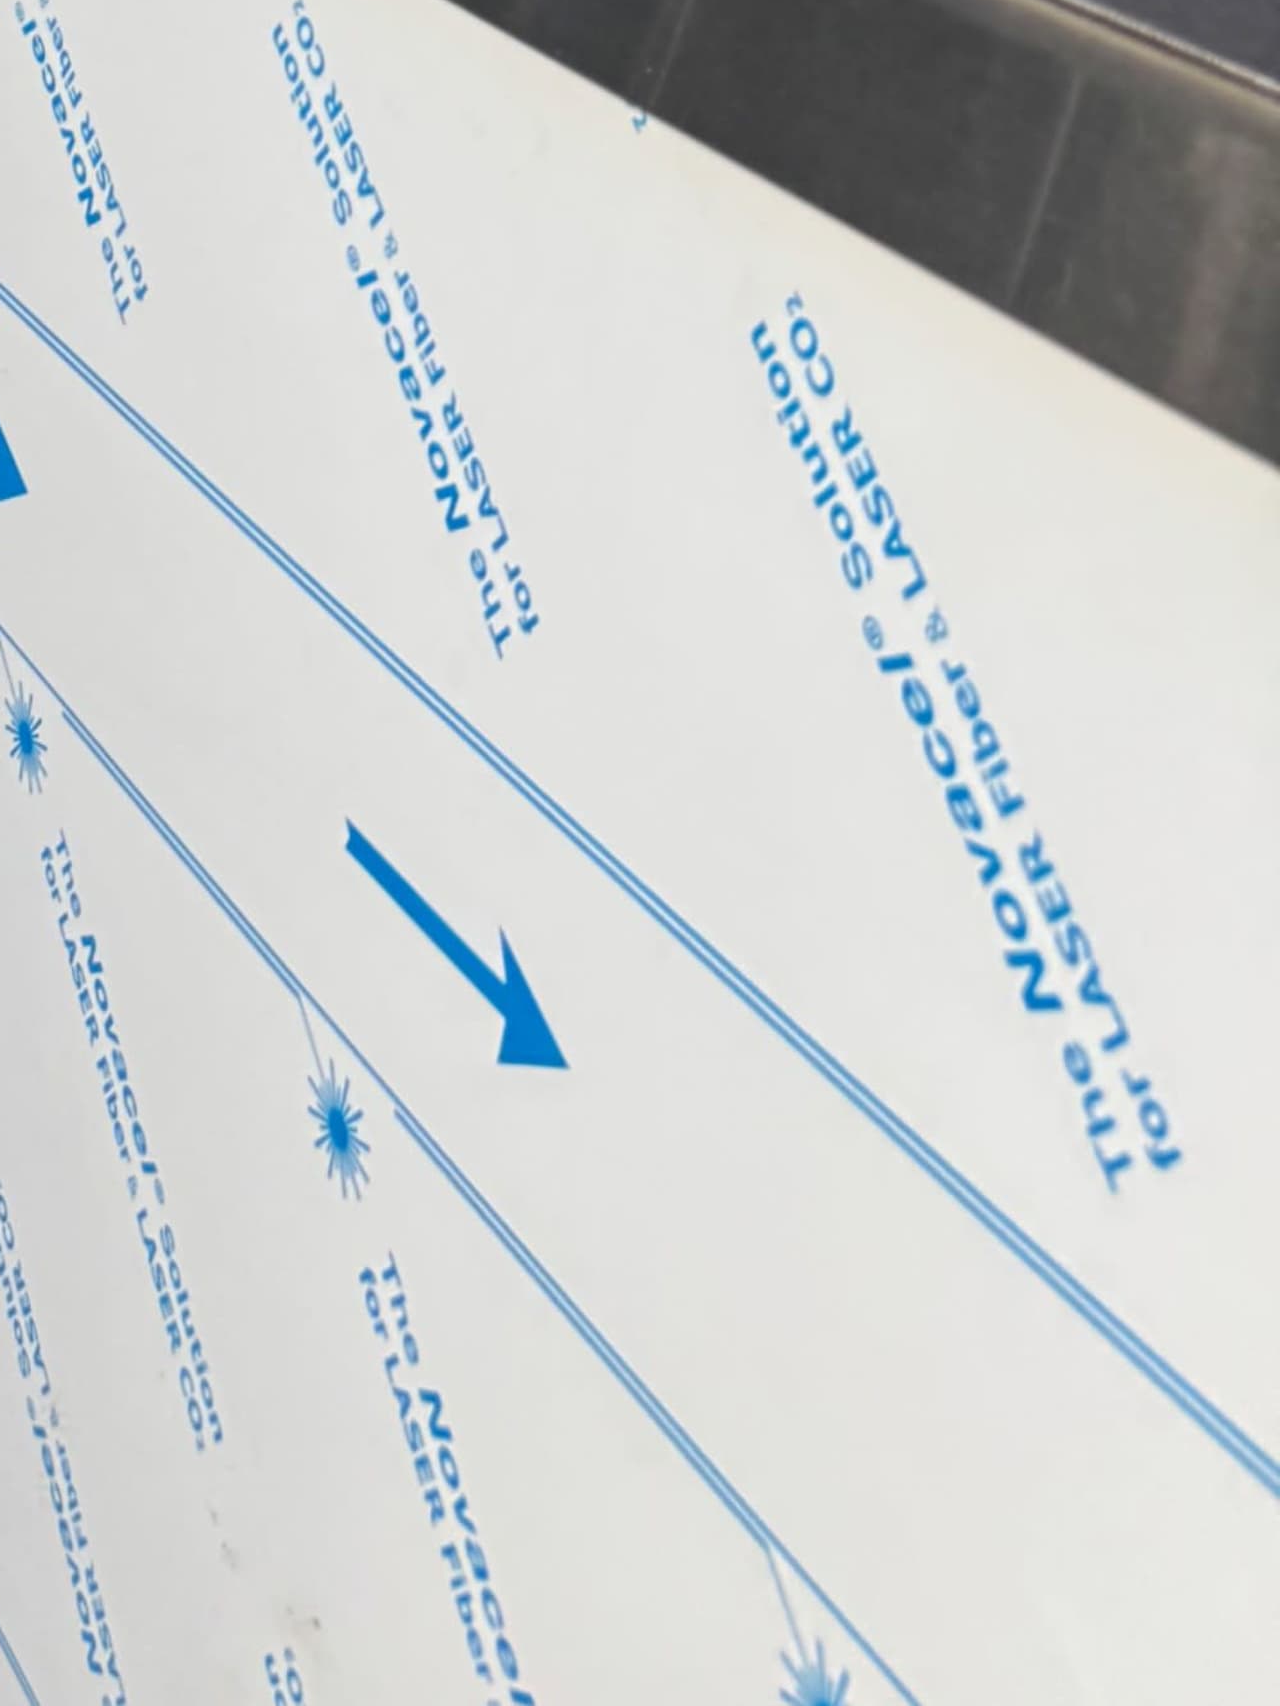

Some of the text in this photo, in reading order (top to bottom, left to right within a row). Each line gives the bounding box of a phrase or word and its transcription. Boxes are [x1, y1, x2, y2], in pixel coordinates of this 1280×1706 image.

[44, 16, 84, 111] Fiber
[270, 22, 353, 228] Solution
[78, 112, 128, 240] LASER
[322, 82, 387, 231] LASER
[99, 236, 131, 325] The
[122, 244, 149, 303] for
[383, 231, 399, 260] &
[393, 270, 448, 388] Fiber
[440, 391, 511, 555] LASER
[748, 320, 876, 594] Solution
[829, 404, 929, 603] LASER
[467, 548, 513, 661] The
[503, 562, 541, 637] for
[923, 607, 950, 645] &
[939, 659, 1028, 821] Fiber
[1018, 830, 1132, 1054] LASER
[39, 845, 62, 903] for
[56, 912, 101, 1047] LASER
[95, 1055, 131, 1163] Fiber
[134, 1207, 183, 1355] LASER
[54, 830, 82, 919] The
[158, 1224, 225, 1446] Solution
[1060, 1040, 1133, 1196] The
[1090, 1066, 1184, 1174] for
[379, 1252, 421, 1368] The
[357, 1266, 493, 1683] for LASER Fiber
